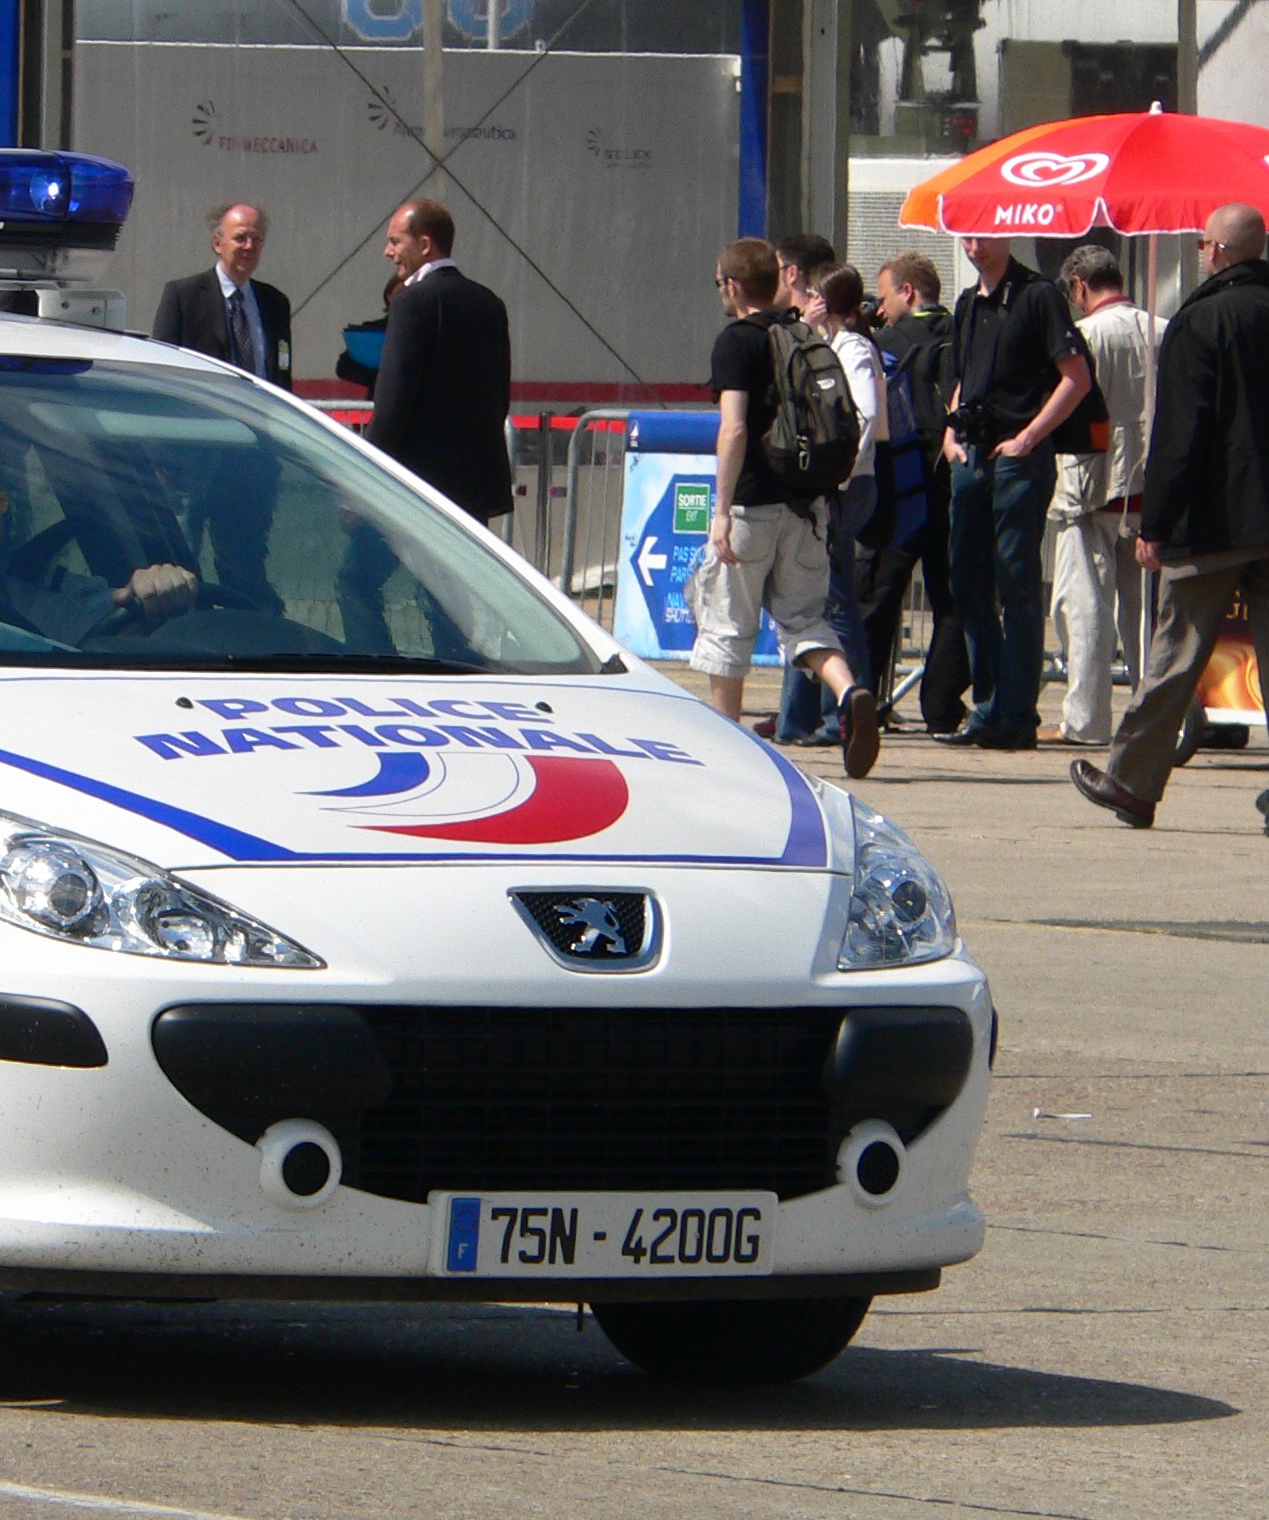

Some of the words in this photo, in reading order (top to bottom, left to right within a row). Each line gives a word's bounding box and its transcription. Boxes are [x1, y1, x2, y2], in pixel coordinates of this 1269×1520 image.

[994, 203, 1055, 226] MIKO
[678, 494, 707, 507] SORTIE
[194, 697, 554, 724] POLICE
[133, 724, 707, 767] NATIONALE
[491, 1207, 579, 1265] 75N
[621, 1207, 762, 1265] 4200G
